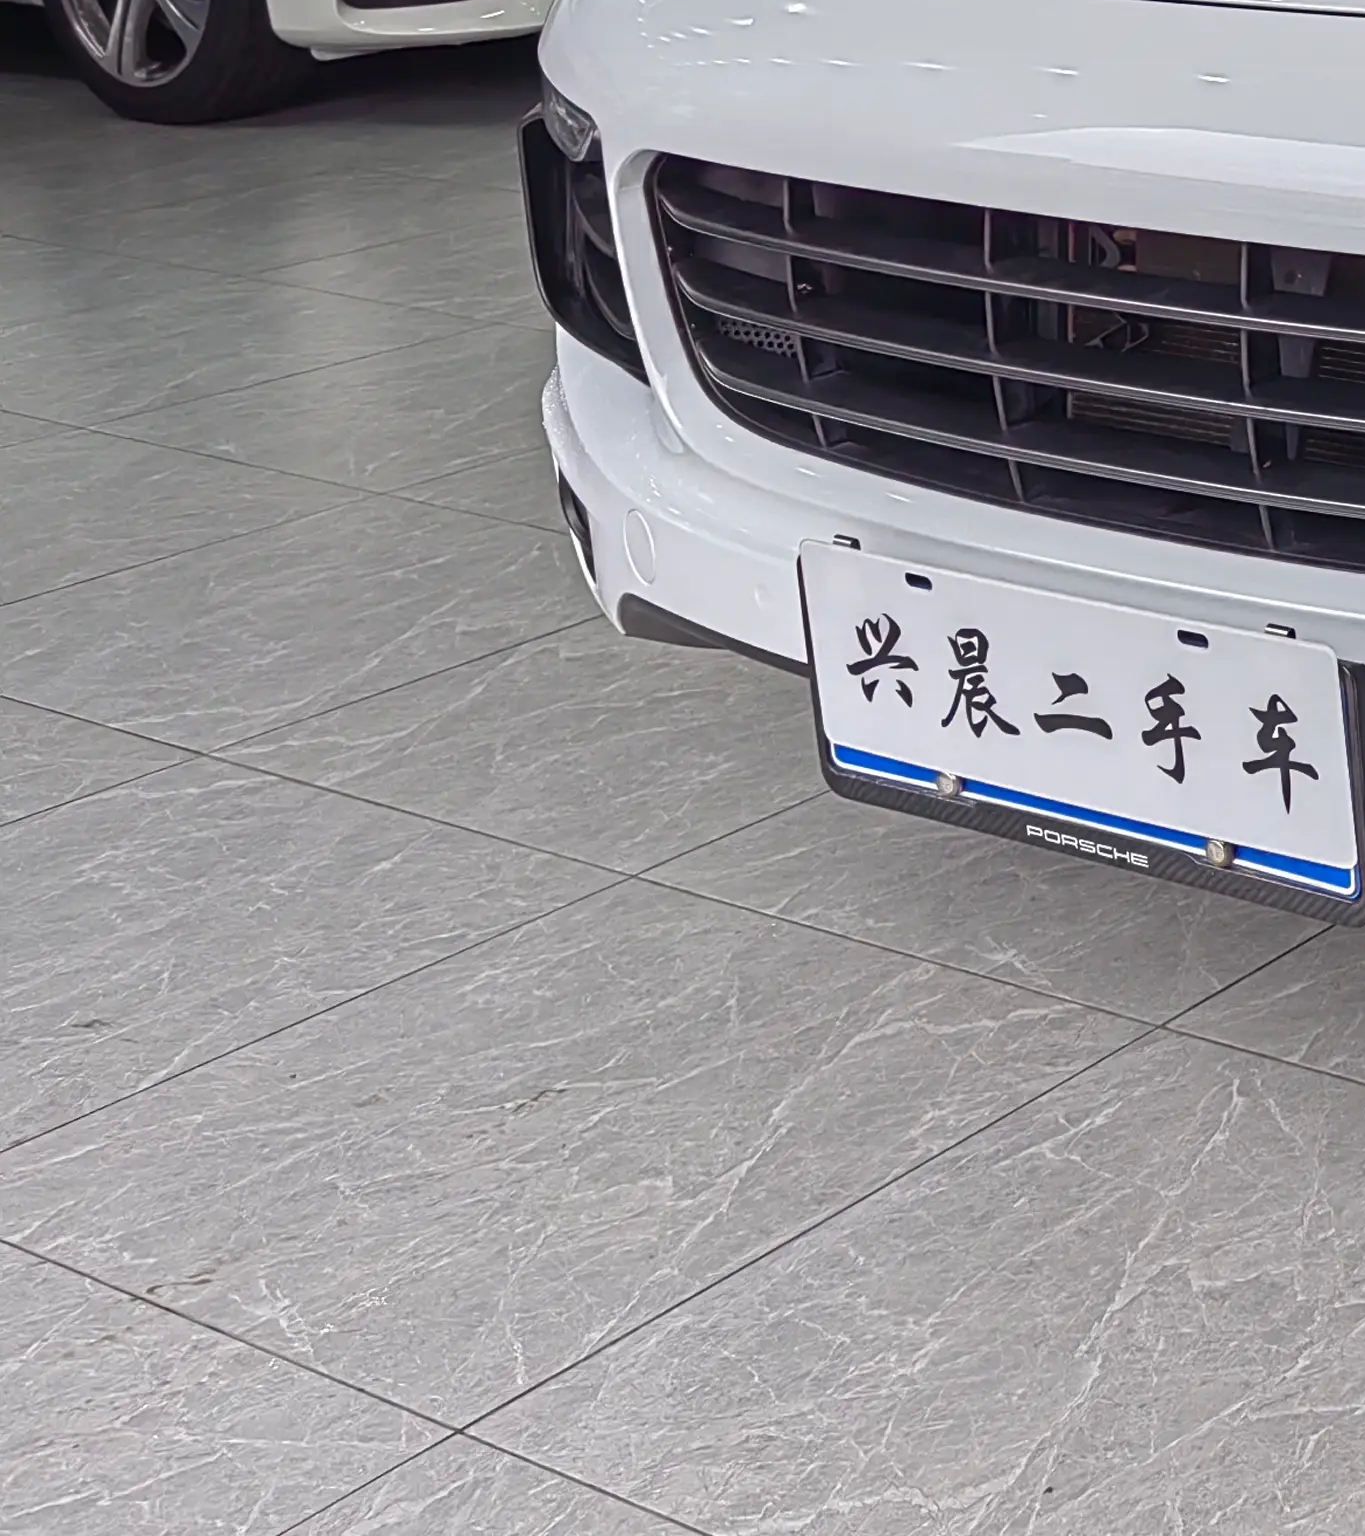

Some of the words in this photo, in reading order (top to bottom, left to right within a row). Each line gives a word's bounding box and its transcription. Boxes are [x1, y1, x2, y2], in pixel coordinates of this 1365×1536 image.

[847, 614, 1319, 815] 兴晨二手车
[1025, 824, 1150, 869] PORSCHE
